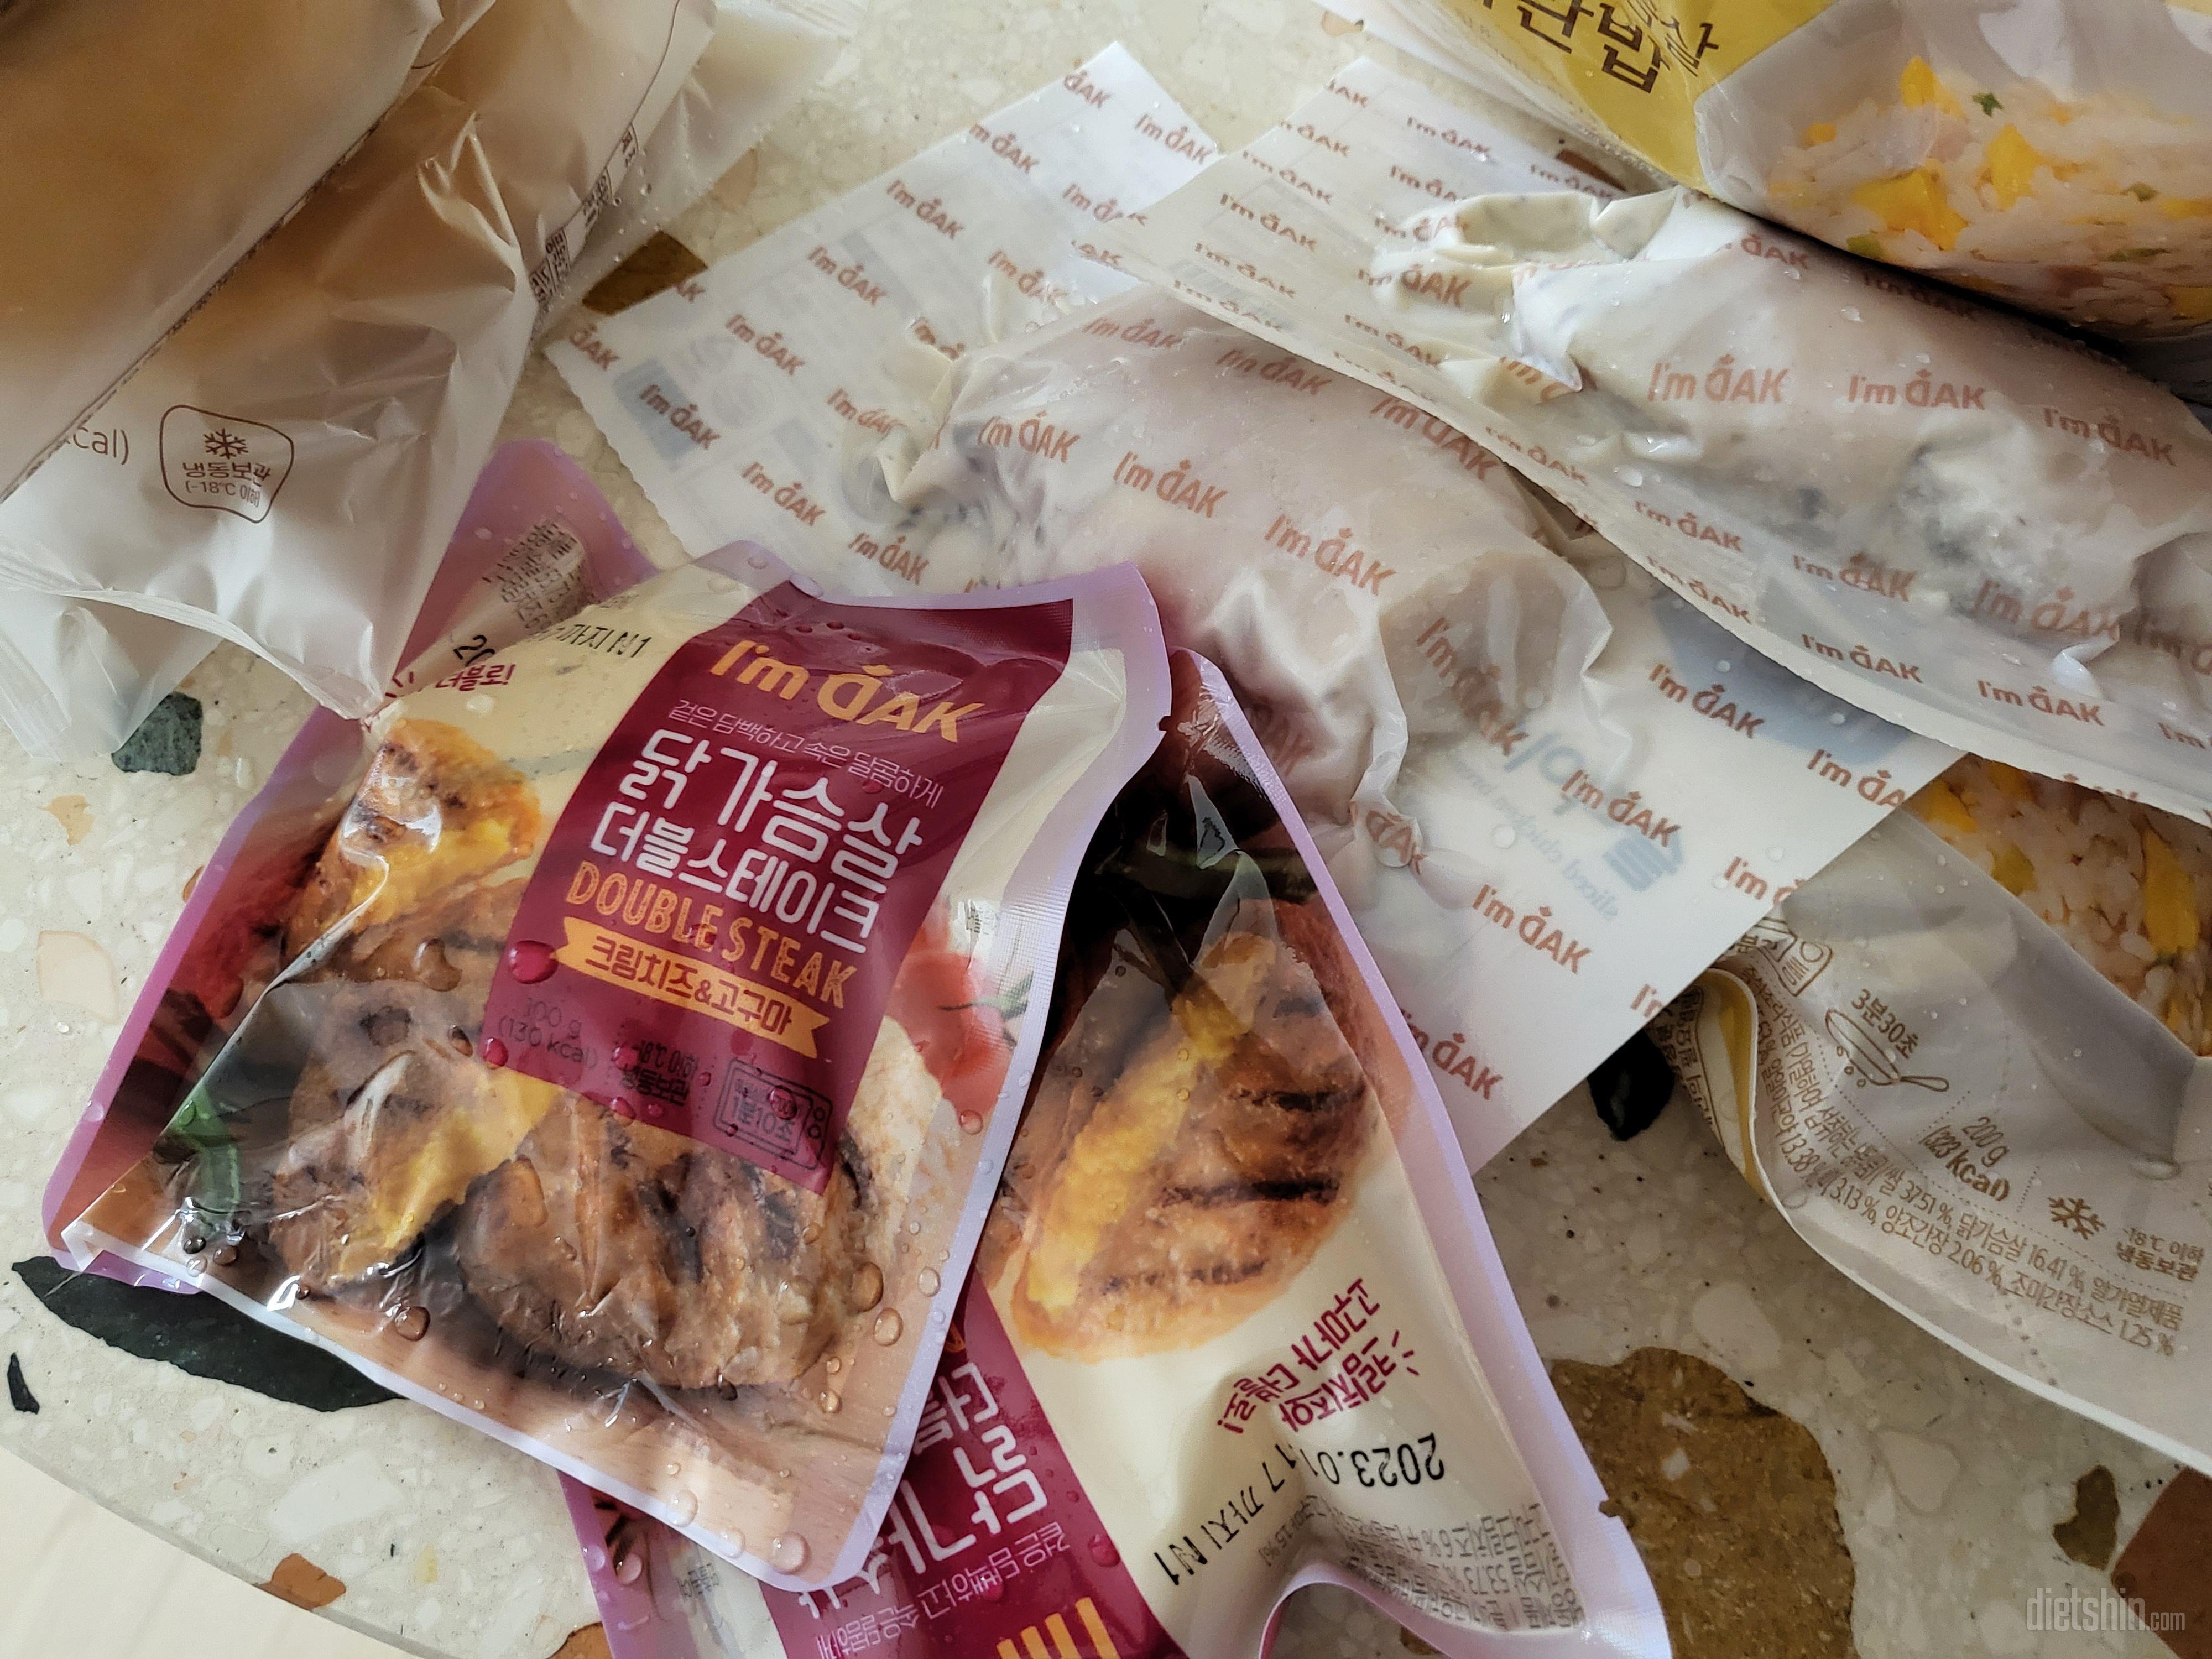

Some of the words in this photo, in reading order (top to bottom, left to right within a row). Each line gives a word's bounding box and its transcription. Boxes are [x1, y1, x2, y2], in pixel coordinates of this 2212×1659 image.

[1135, 114, 1162, 140] I'm
[1407, 117, 1437, 137] I'm
[1244, 150, 1274, 173] I'm
[1391, 165, 1421, 190] I'm
[1530, 165, 1560, 184] I'm
[885, 179, 916, 208] I'm
[1061, 184, 1092, 211] I'm
[1219, 194, 1254, 220] I'm
[807, 246, 837, 275] I'm
[988, 251, 1018, 279] I'm
[1194, 243, 1230, 267] I'm
[726, 314, 757, 343] I'm
[1217, 349, 1257, 373] I'm
[1646, 361, 1697, 403] I'm
[1848, 374, 1896, 405] I'm
[640, 384, 671, 414] I'm
[827, 388, 857, 421] I'm
[1370, 396, 1423, 429] I'm
[977, 415, 1013, 447] I'm
[2043, 407, 2091, 439] I'm
[182, 461, 271, 487] 냉동보관
[742, 462, 772, 494] I'm
[1112, 450, 1154, 492] I'm
[1634, 500, 1671, 528] I'm
[848, 531, 878, 561] I'm
[1264, 514, 1312, 559] I'm
[1646, 556, 1684, 585] I'm
[1792, 554, 1834, 580] I'm
[1970, 579, 2023, 624] I'm
[1801, 634, 1844, 661] I'm
[710, 640, 810, 700] I'm
[1648, 663, 1688, 703] I'm
[1977, 680, 2023, 707] I'm
[2158, 722, 2205, 749] I'm
[668, 699, 717, 729] 겉은
[713, 712, 804, 754] 담백하고
[804, 739, 851, 769] 속은
[849, 752, 943, 810] 달콤하게
[1807, 748, 1852, 787] I'm
[1561, 768, 1604, 810] I'm
[619, 728, 925, 894] 닭가슴살
[591, 801, 880, 953] 더블스테이크
[1723, 856, 1768, 900] I'm
[1472, 883, 1515, 929] I'm
[564, 860, 724, 950] DOUBLE
[723, 916, 858, 1009] STEAK
[586, 935, 794, 1037] 크림치즈&고구마
[524, 997, 563, 1028] 100
[567, 1019, 582, 1040] g
[1852, 989, 1918, 1058] 3분30초
[498, 1017, 542, 1048] (130
[546, 1031, 599, 1070] kcal)
[1963, 1116, 2004, 1148] 200
[1981, 1146, 2009, 1167] g
[1953, 1211, 2028, 1262] 닭가슴살
[2169, 1241, 2205, 1263] 이하
[1881, 1204, 1949, 1255] 양조간장
[2004, 1270, 2114, 1335] 조미간장소스
[2116, 1241, 2199, 1283] 냉동보관
[1291, 1277, 1380, 1371] 고구마가
[1217, 1363, 1299, 1434] 더블로!
[1280, 1337, 1396, 1433] 크림치즈와
[1203, 1485, 1264, 1551] 까지
[1014, 1521, 1071, 1568] 겉은
[1153, 1535, 1208, 1586] N1
[916, 1547, 1021, 1620] 담백하고
[876, 1604, 920, 1640] 속은
